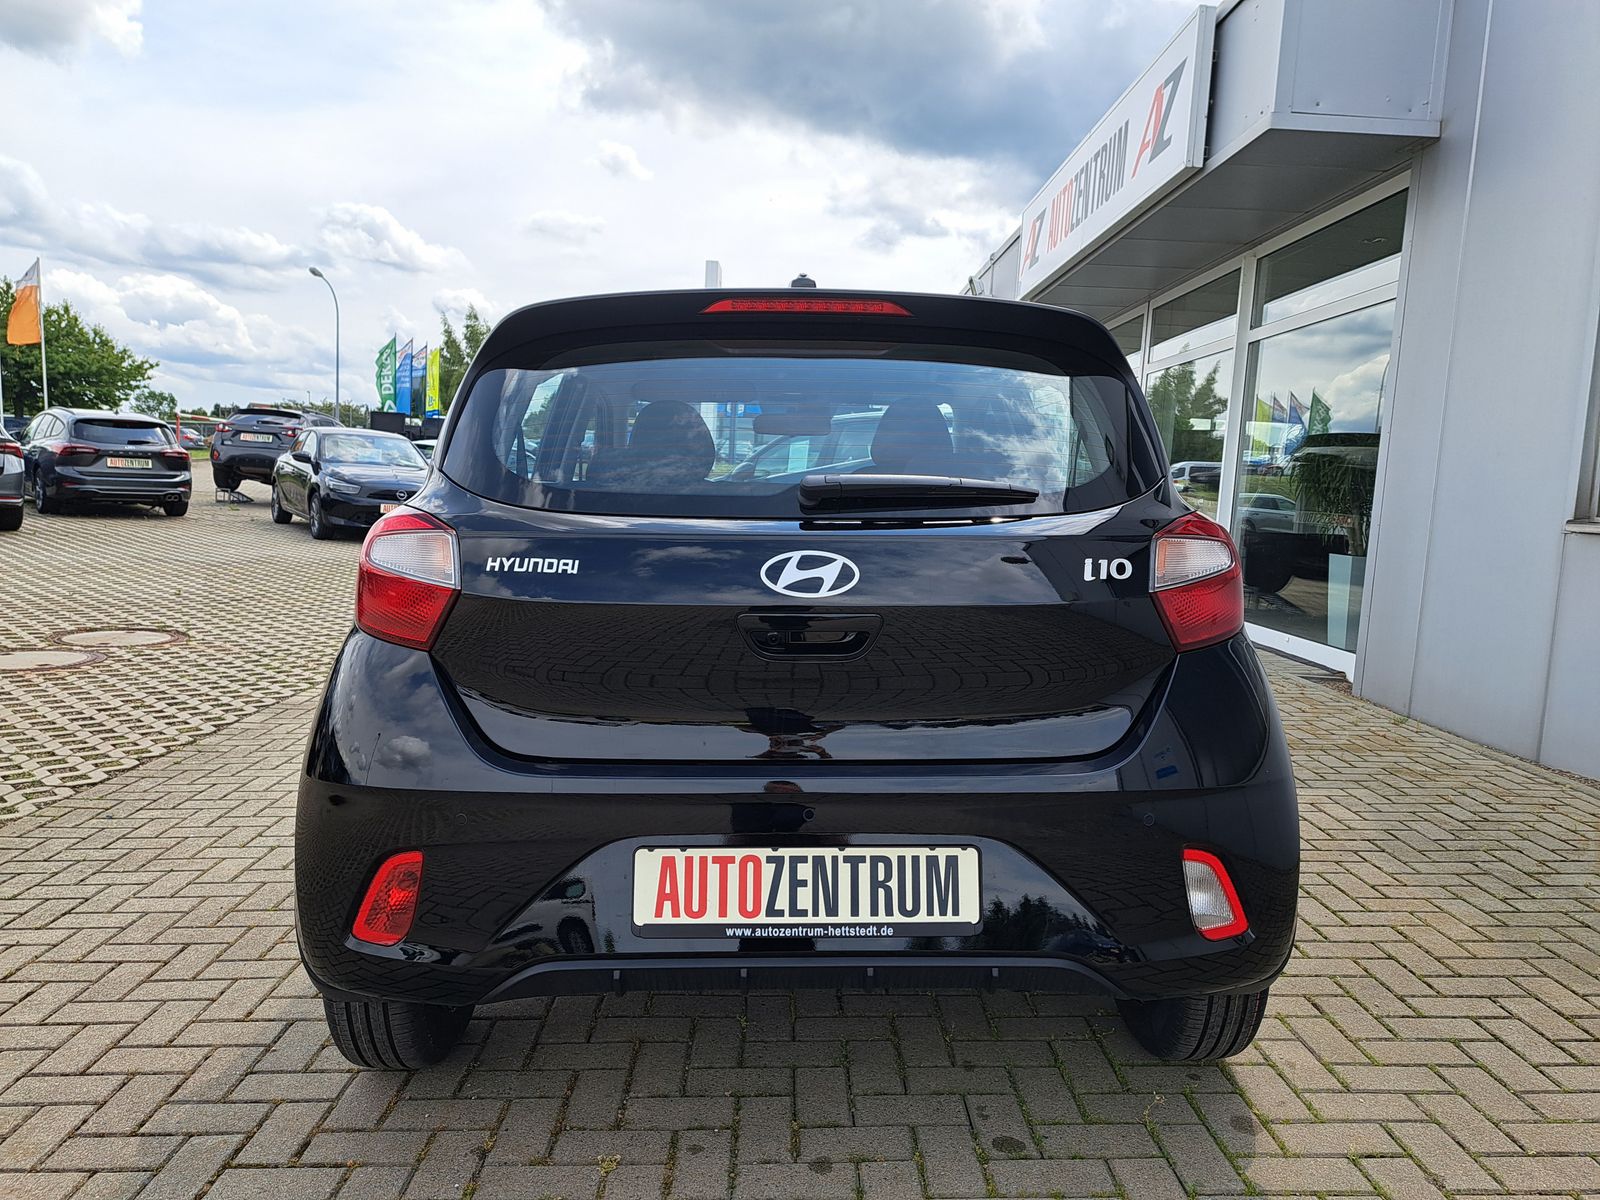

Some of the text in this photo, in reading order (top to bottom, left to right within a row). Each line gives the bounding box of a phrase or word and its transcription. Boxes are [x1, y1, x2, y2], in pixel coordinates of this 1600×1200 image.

[1021, 56, 1188, 277] AZ AUTOZENTRUM AZ
[109, 457, 150, 467] AUTOZENTRUM
[486, 557, 580, 574] HYUNDAI
[1083, 557, 1133, 582] i10
[654, 853, 961, 919] AUTOZENTRUM
[725, 925, 894, 938] www.autozentrum-hettstedt.de
